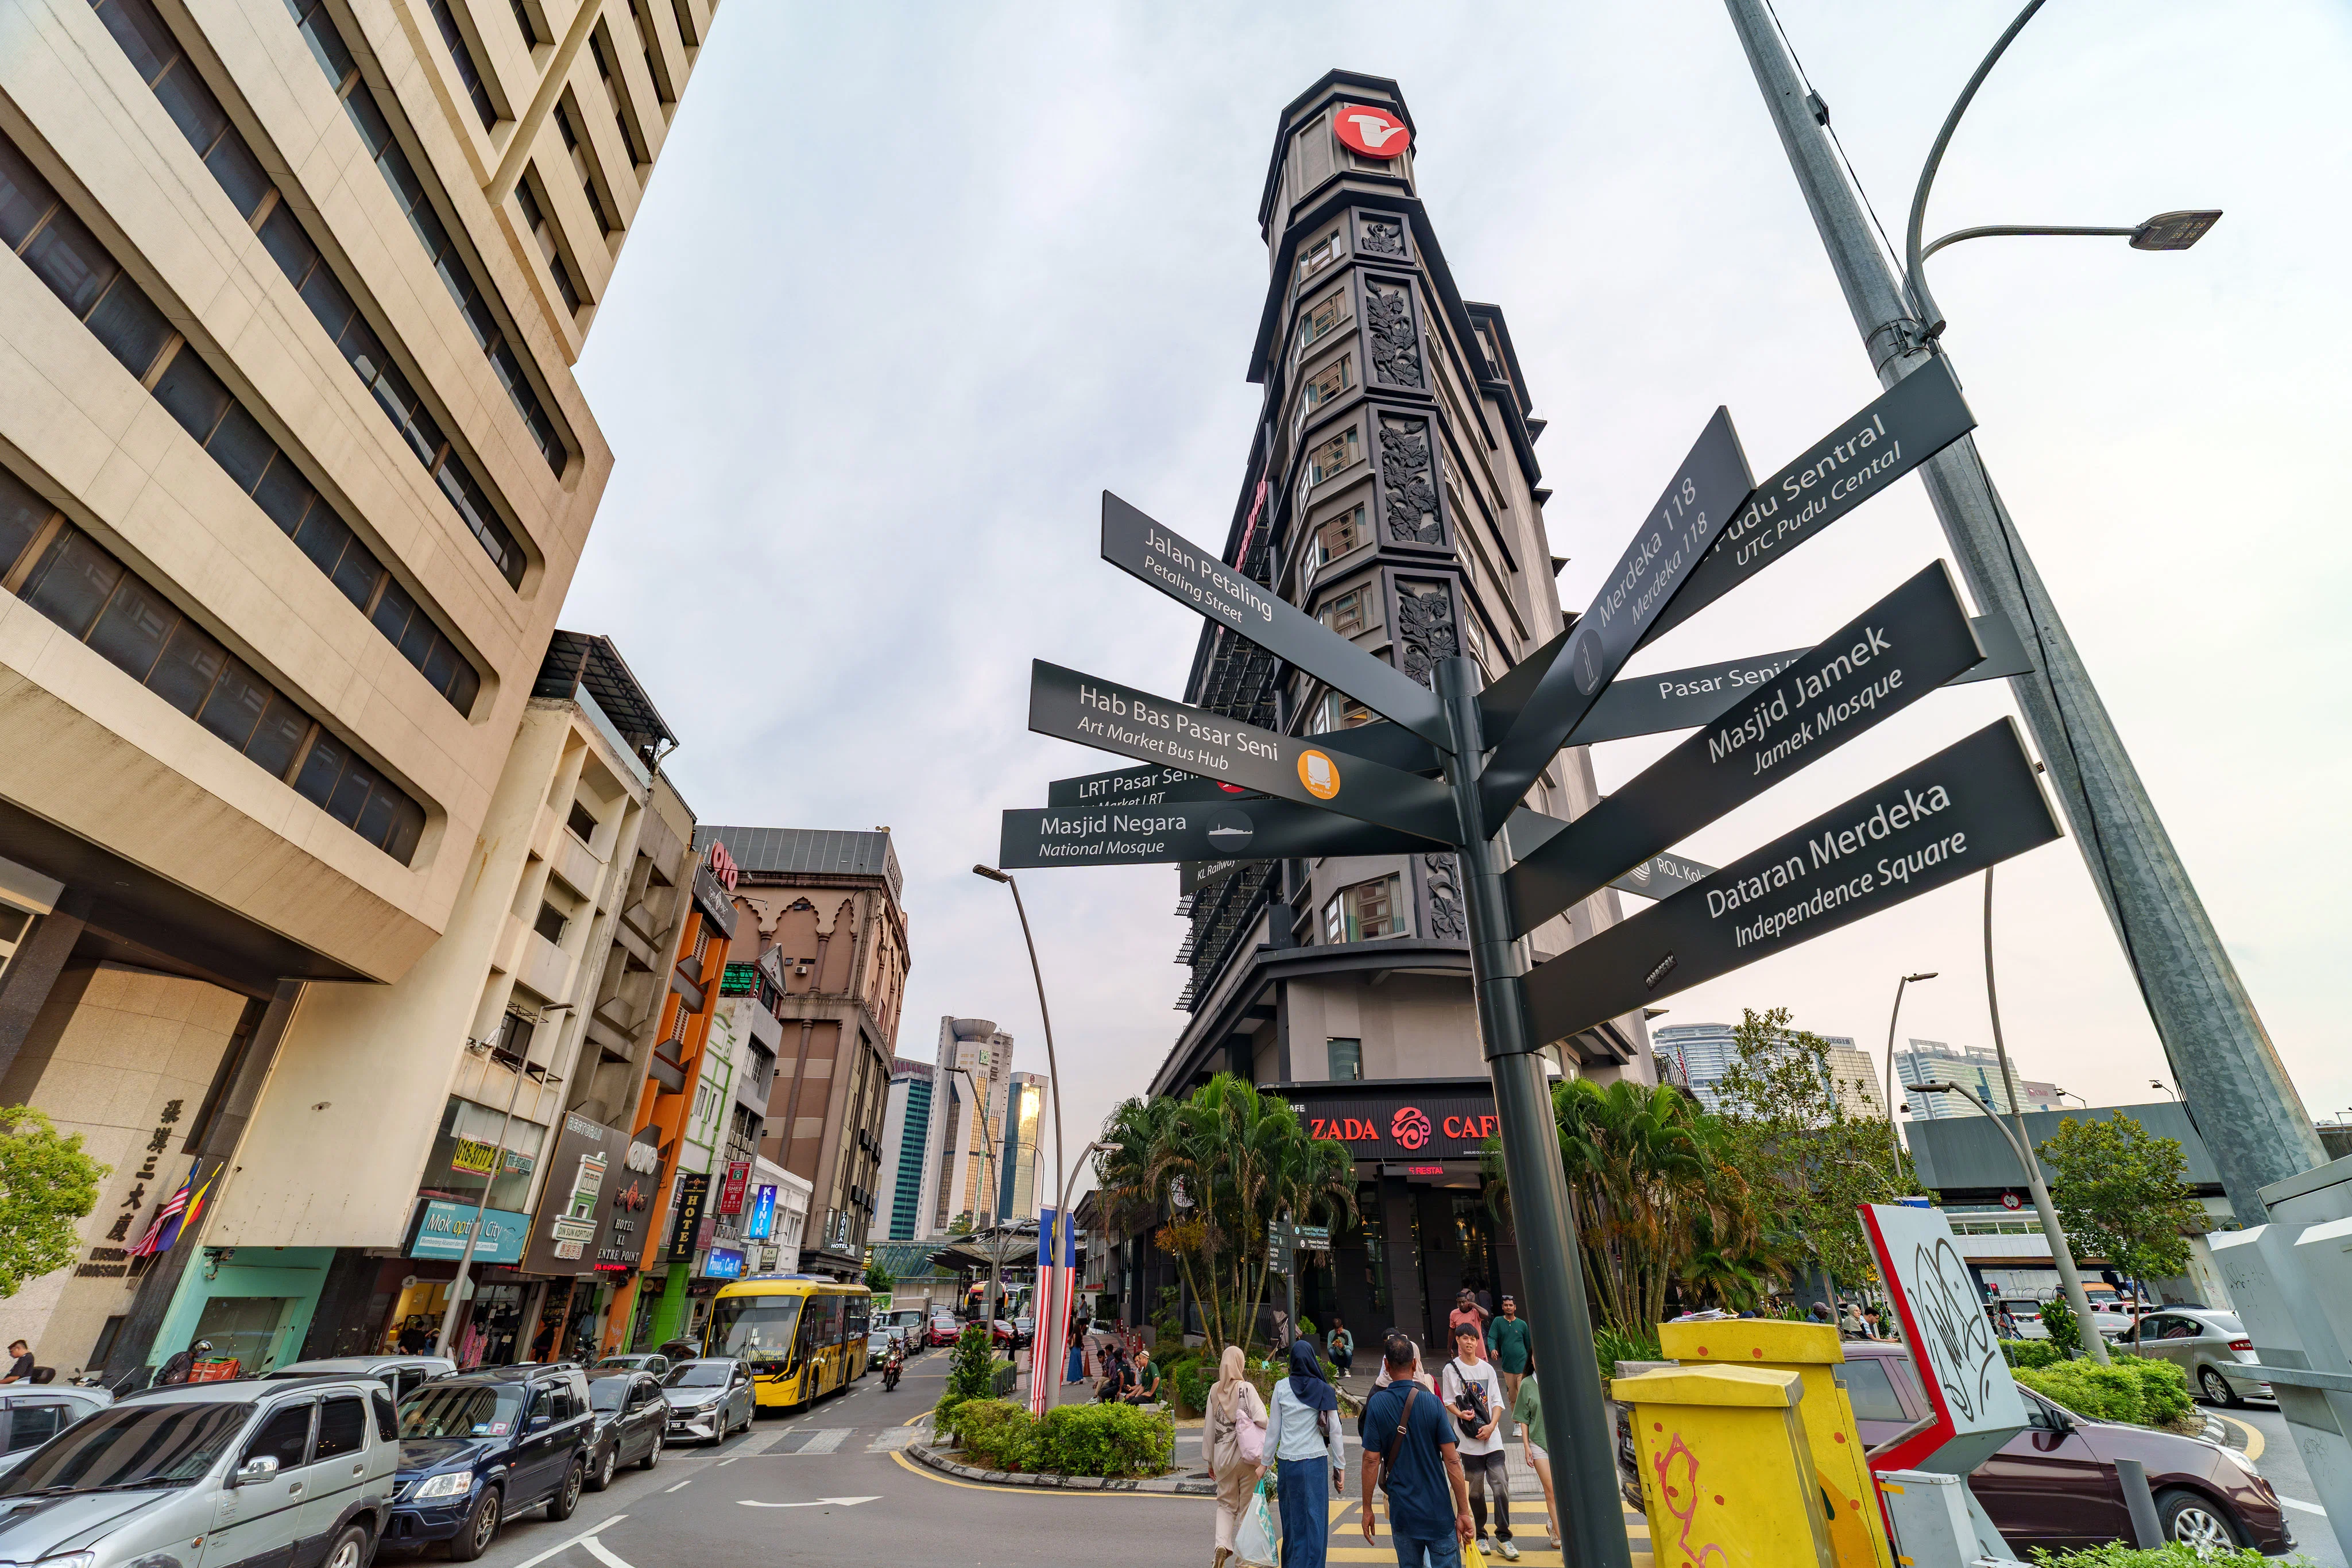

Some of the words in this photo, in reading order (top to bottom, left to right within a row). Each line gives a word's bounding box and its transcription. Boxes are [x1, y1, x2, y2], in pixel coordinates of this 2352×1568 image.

[1782, 413, 1886, 501] Sentral
[1736, 529, 1774, 566] UTC
[1777, 497, 1827, 540] Pudu
[1831, 440, 1901, 500] Cental
[1599, 532, 1662, 628] Merdeka
[1662, 477, 1696, 531] 118
[1631, 549, 1681, 625] Merdeka
[1682, 511, 1707, 553] 118
[1144, 555, 1202, 602] Petaling
[1205, 591, 1242, 623] Street
[1146, 528, 1195, 572] Jalan
[1201, 560, 1272, 622] Petaling
[1658, 675, 1722, 699] Pasar
[1728, 659, 1798, 687] Seni
[1708, 689, 1788, 764] Masjid
[1796, 626, 1891, 708] Jamek
[1081, 684, 1127, 716] Hab
[1134, 701, 1170, 729] Bas
[1177, 714, 1231, 746] Pasar
[1237, 733, 1278, 761] Seni
[1754, 722, 1813, 775] Jamek
[1817, 669, 1903, 735] Mosque
[1077, 717, 1104, 736] Art
[1107, 724, 1165, 752] Market
[1168, 741, 1194, 761] Bus
[1198, 749, 1228, 771] Hub
[1080, 779, 1109, 798] LRT
[1113, 774, 1158, 792] Pasar
[1162, 768, 1199, 784] Se
[1142, 792, 1166, 805] LRT
[1040, 815, 1107, 838] Masjid
[1113, 815, 1186, 835] Negara
[1039, 841, 1104, 857] National
[1106, 840, 1165, 857] Mosque
[1707, 855, 1805, 919] Dataran
[1809, 784, 1951, 869] Merdeka
[711, 842, 738, 892] OYO
[1197, 868, 1206, 881] KL
[1208, 860, 1235, 876] Railway
[1657, 857, 1682, 878] ROL
[1682, 865, 1706, 882] Kol
[1735, 872, 1874, 947] Independence
[1877, 831, 1967, 886] Square
[467, 1133, 482, 1143] SALE
[488, 1139, 499, 1147] REN
[567, 1117, 603, 1141] RESTORAN
[1311, 1118, 1379, 1140] ZADA
[626, 1141, 658, 1175] OYO
[426, 1213, 452, 1233] Mok
[453, 1218, 485, 1238] optil
[485, 1221, 502, 1242] City
[615, 1218, 634, 1232] HOTEL
[676, 1195, 698, 1254] HOTEL
[755, 1187, 771, 1236] KLINIK
[838, 1212, 846, 1242] LAVANA
[566, 1228, 575, 1237] SUN
[575, 1228, 593, 1241] KOPITIAM
[616, 1234, 625, 1245] KL
[597, 1248, 618, 1260] ENTRE
[621, 1250, 640, 1262] POINT
[712, 1248, 721, 1256] KLINIK
